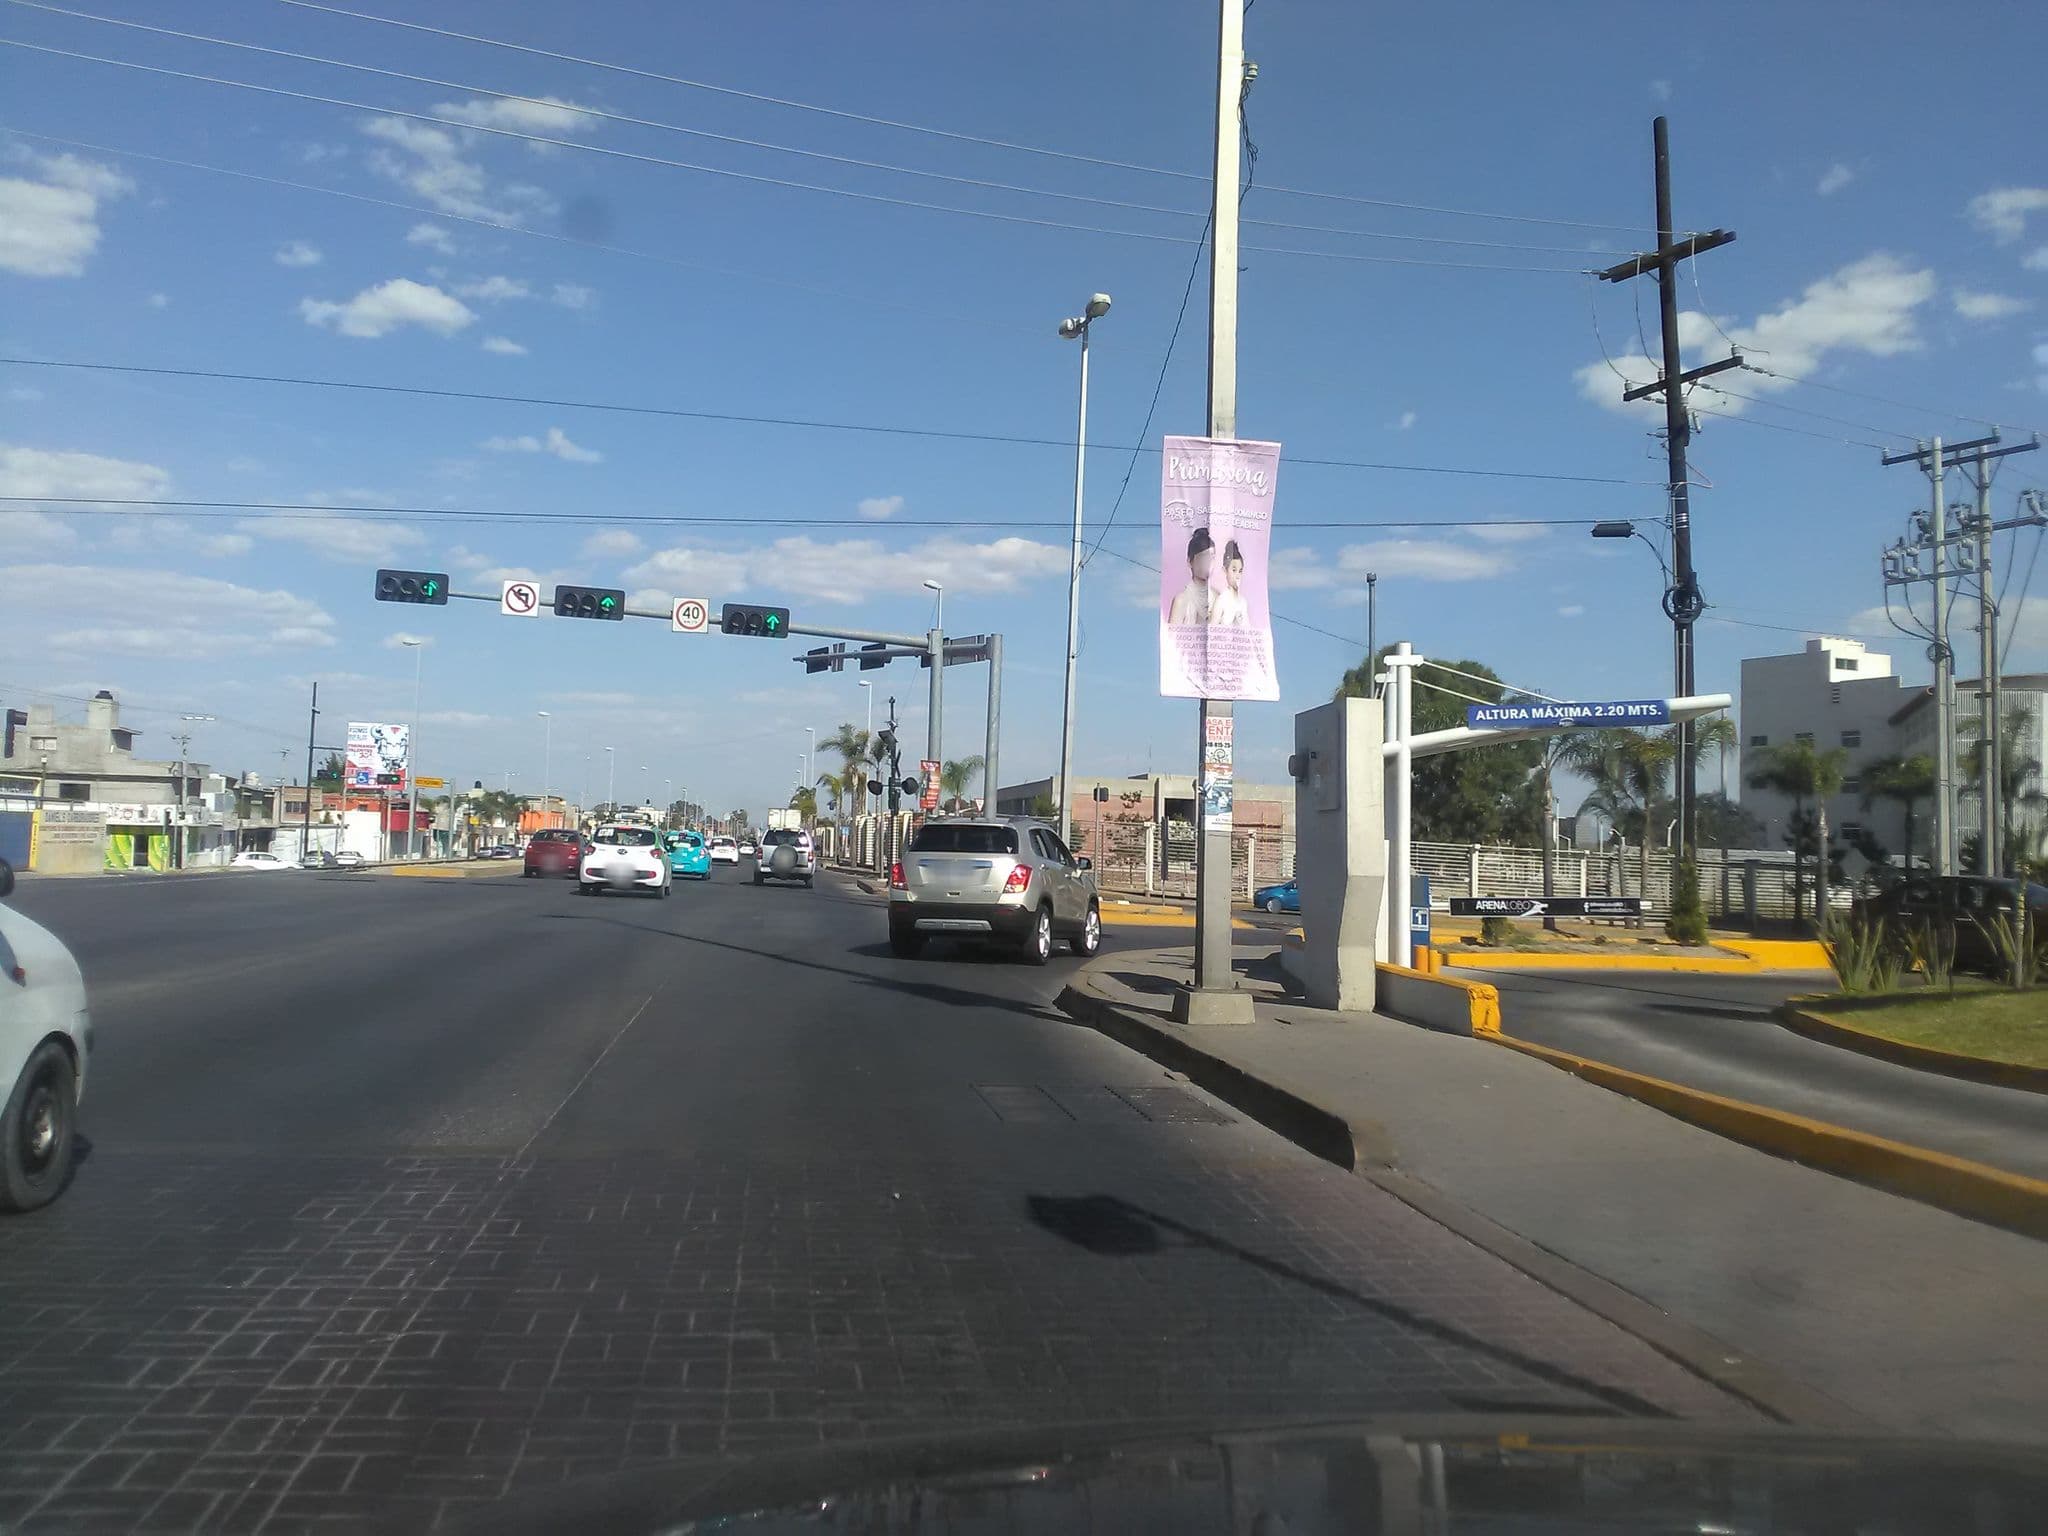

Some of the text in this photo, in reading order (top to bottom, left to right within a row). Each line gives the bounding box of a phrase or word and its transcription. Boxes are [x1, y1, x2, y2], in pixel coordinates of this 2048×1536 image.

[1169, 456, 1268, 488] Primavera
[683, 606, 700, 619] 40
[1475, 704, 1662, 720] ALTURA MÁXIMA 2.20 MTS.
[1208, 726, 1233, 736] ENT
